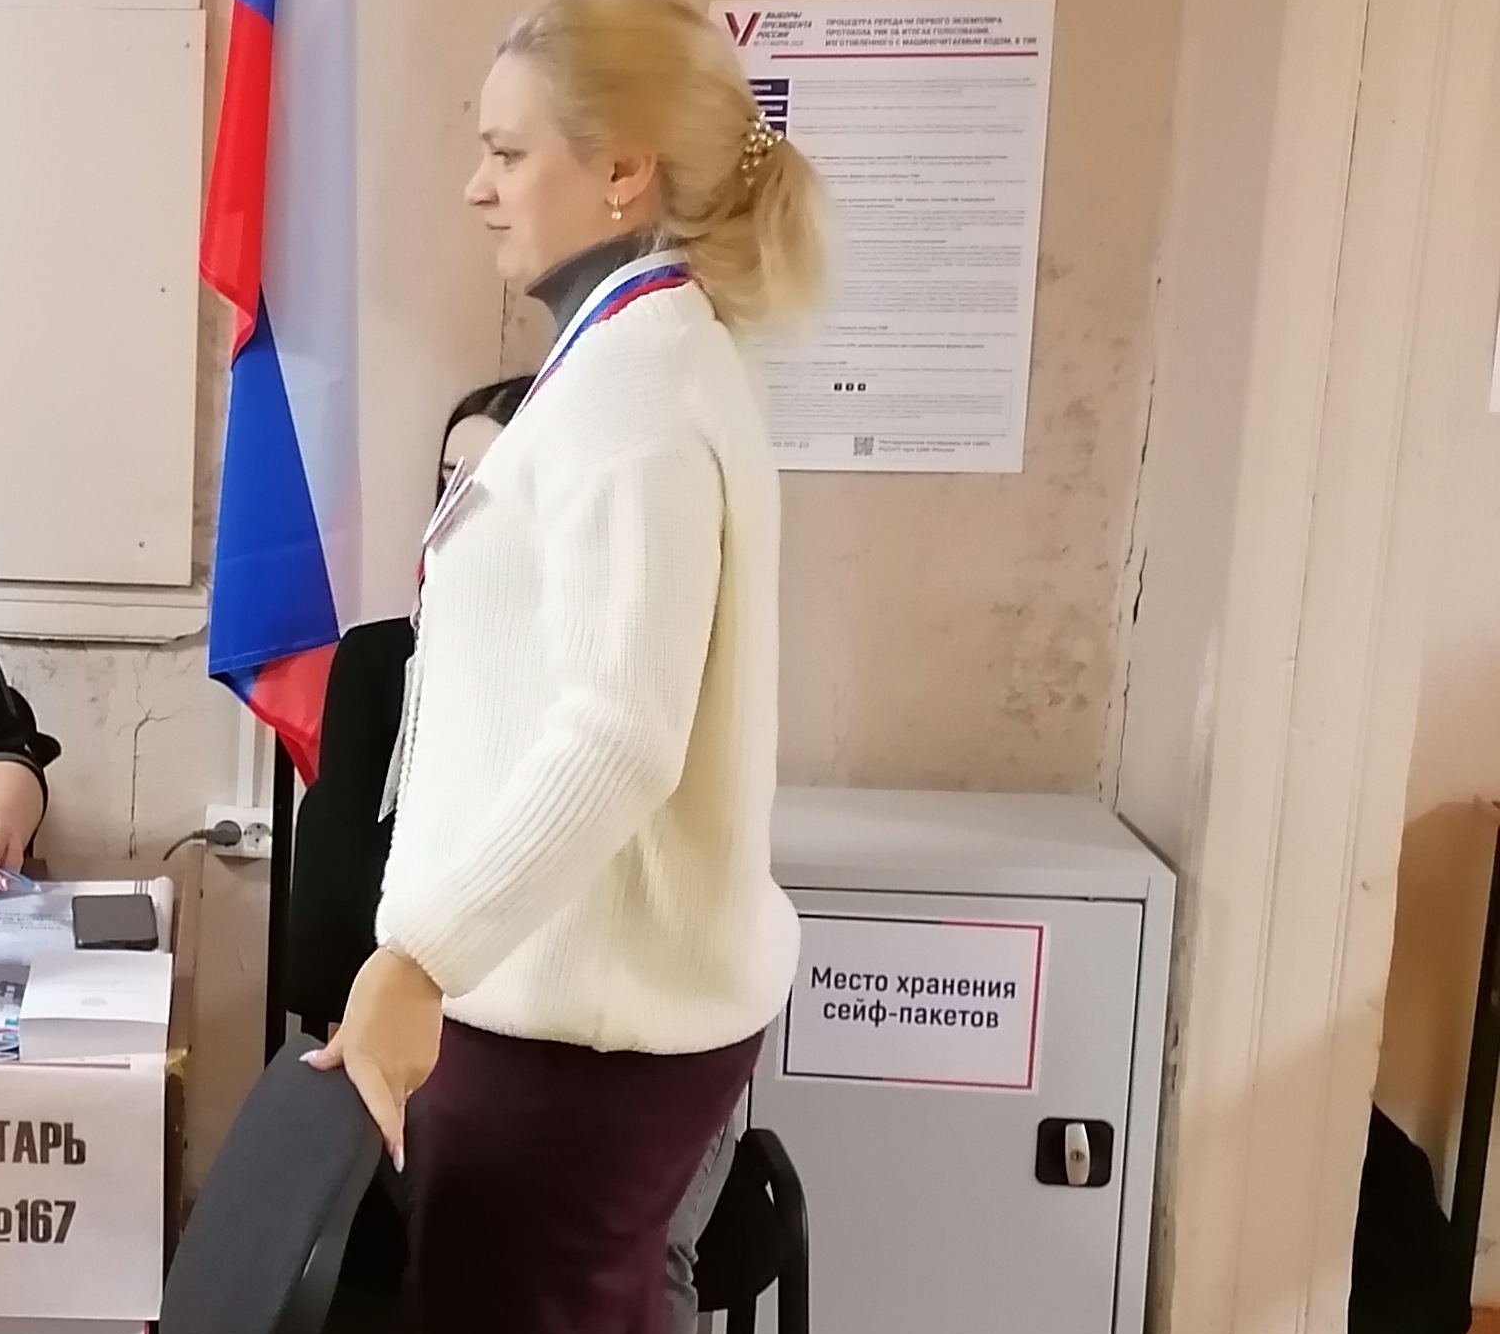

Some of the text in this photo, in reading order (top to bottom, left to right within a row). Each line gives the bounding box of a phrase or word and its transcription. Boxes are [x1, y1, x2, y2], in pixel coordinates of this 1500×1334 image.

[765, 11, 803, 19] ВЫБОРЫ
[761, 20, 813, 29] ПРЕЗИДЕНТА
[826, 18, 873, 27] ПРОЦЕДУРА
[874, 17, 915, 26] ПЕРЕДАЧИ
[916, 17, 950, 25] ПЕРВОГО
[756, 31, 790, 39] РОССИИ
[825, 29, 872, 37] ПРОТОКОЛА
[901, 27, 931, 36] ИТОГАХ
[810, 965, 1016, 1000] Место хранения
[822, 998, 1000, 1029] сейф-пакетов
